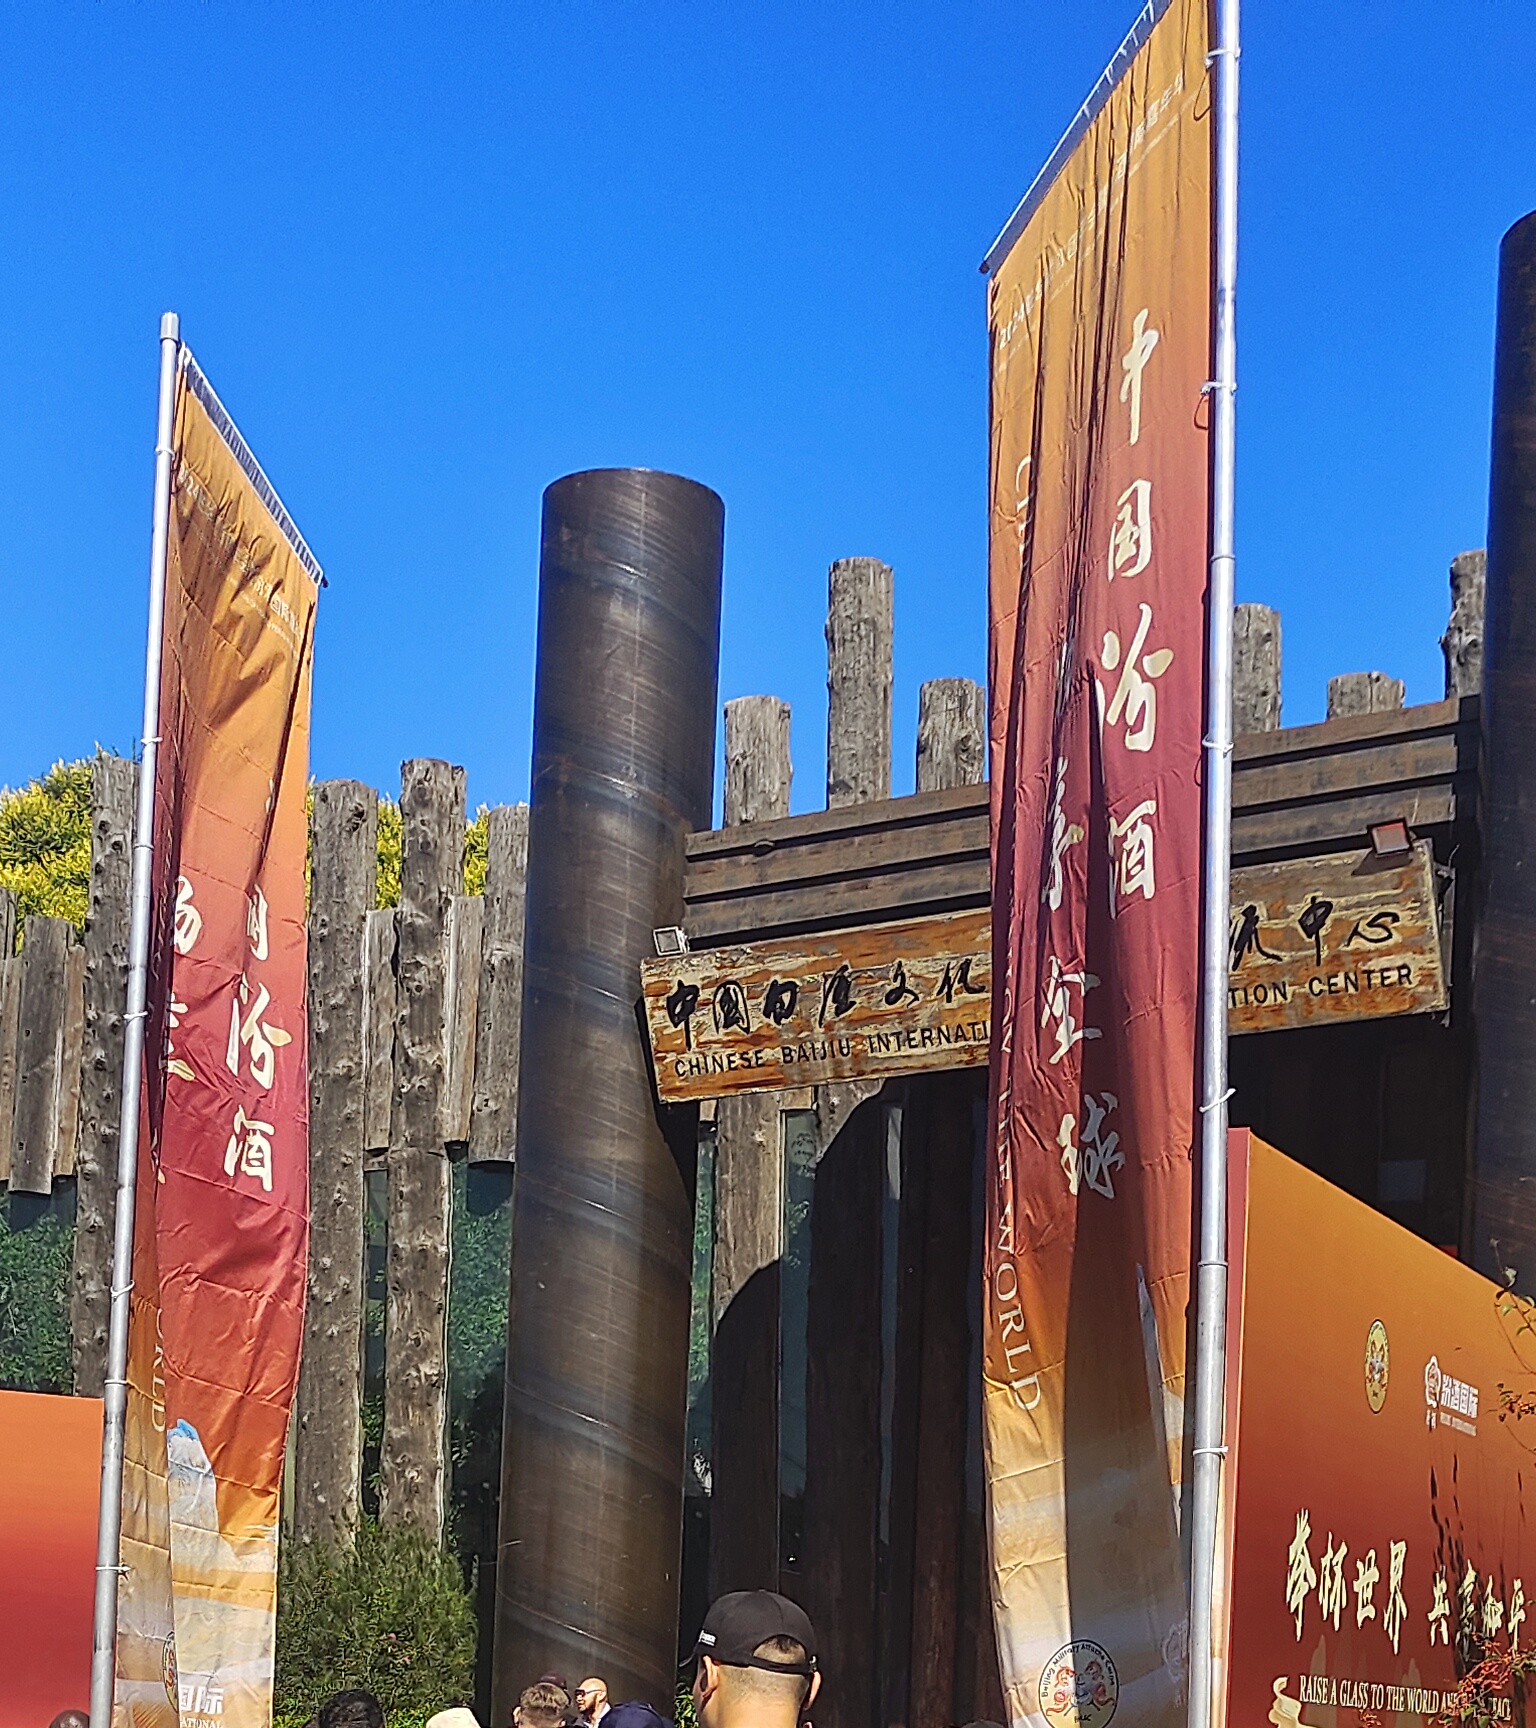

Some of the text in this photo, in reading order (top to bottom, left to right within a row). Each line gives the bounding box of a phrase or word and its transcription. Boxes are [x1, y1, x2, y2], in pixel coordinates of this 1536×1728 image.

[1095, 308, 1173, 920] 中国汾酒
[674, 1053, 765, 1078] CHINESE
[782, 1040, 852, 1065] BAIJIU
[1309, 964, 1413, 998] CENTER
[1299, 1675, 1329, 1704] RAISE
[1329, 1678, 1338, 1706] A
[1339, 1680, 1368, 1708] GLASS
[1370, 1684, 1384, 1710] TO
[1386, 1686, 1405, 1712] THE
[1405, 1687, 1439, 1714] WORLD
